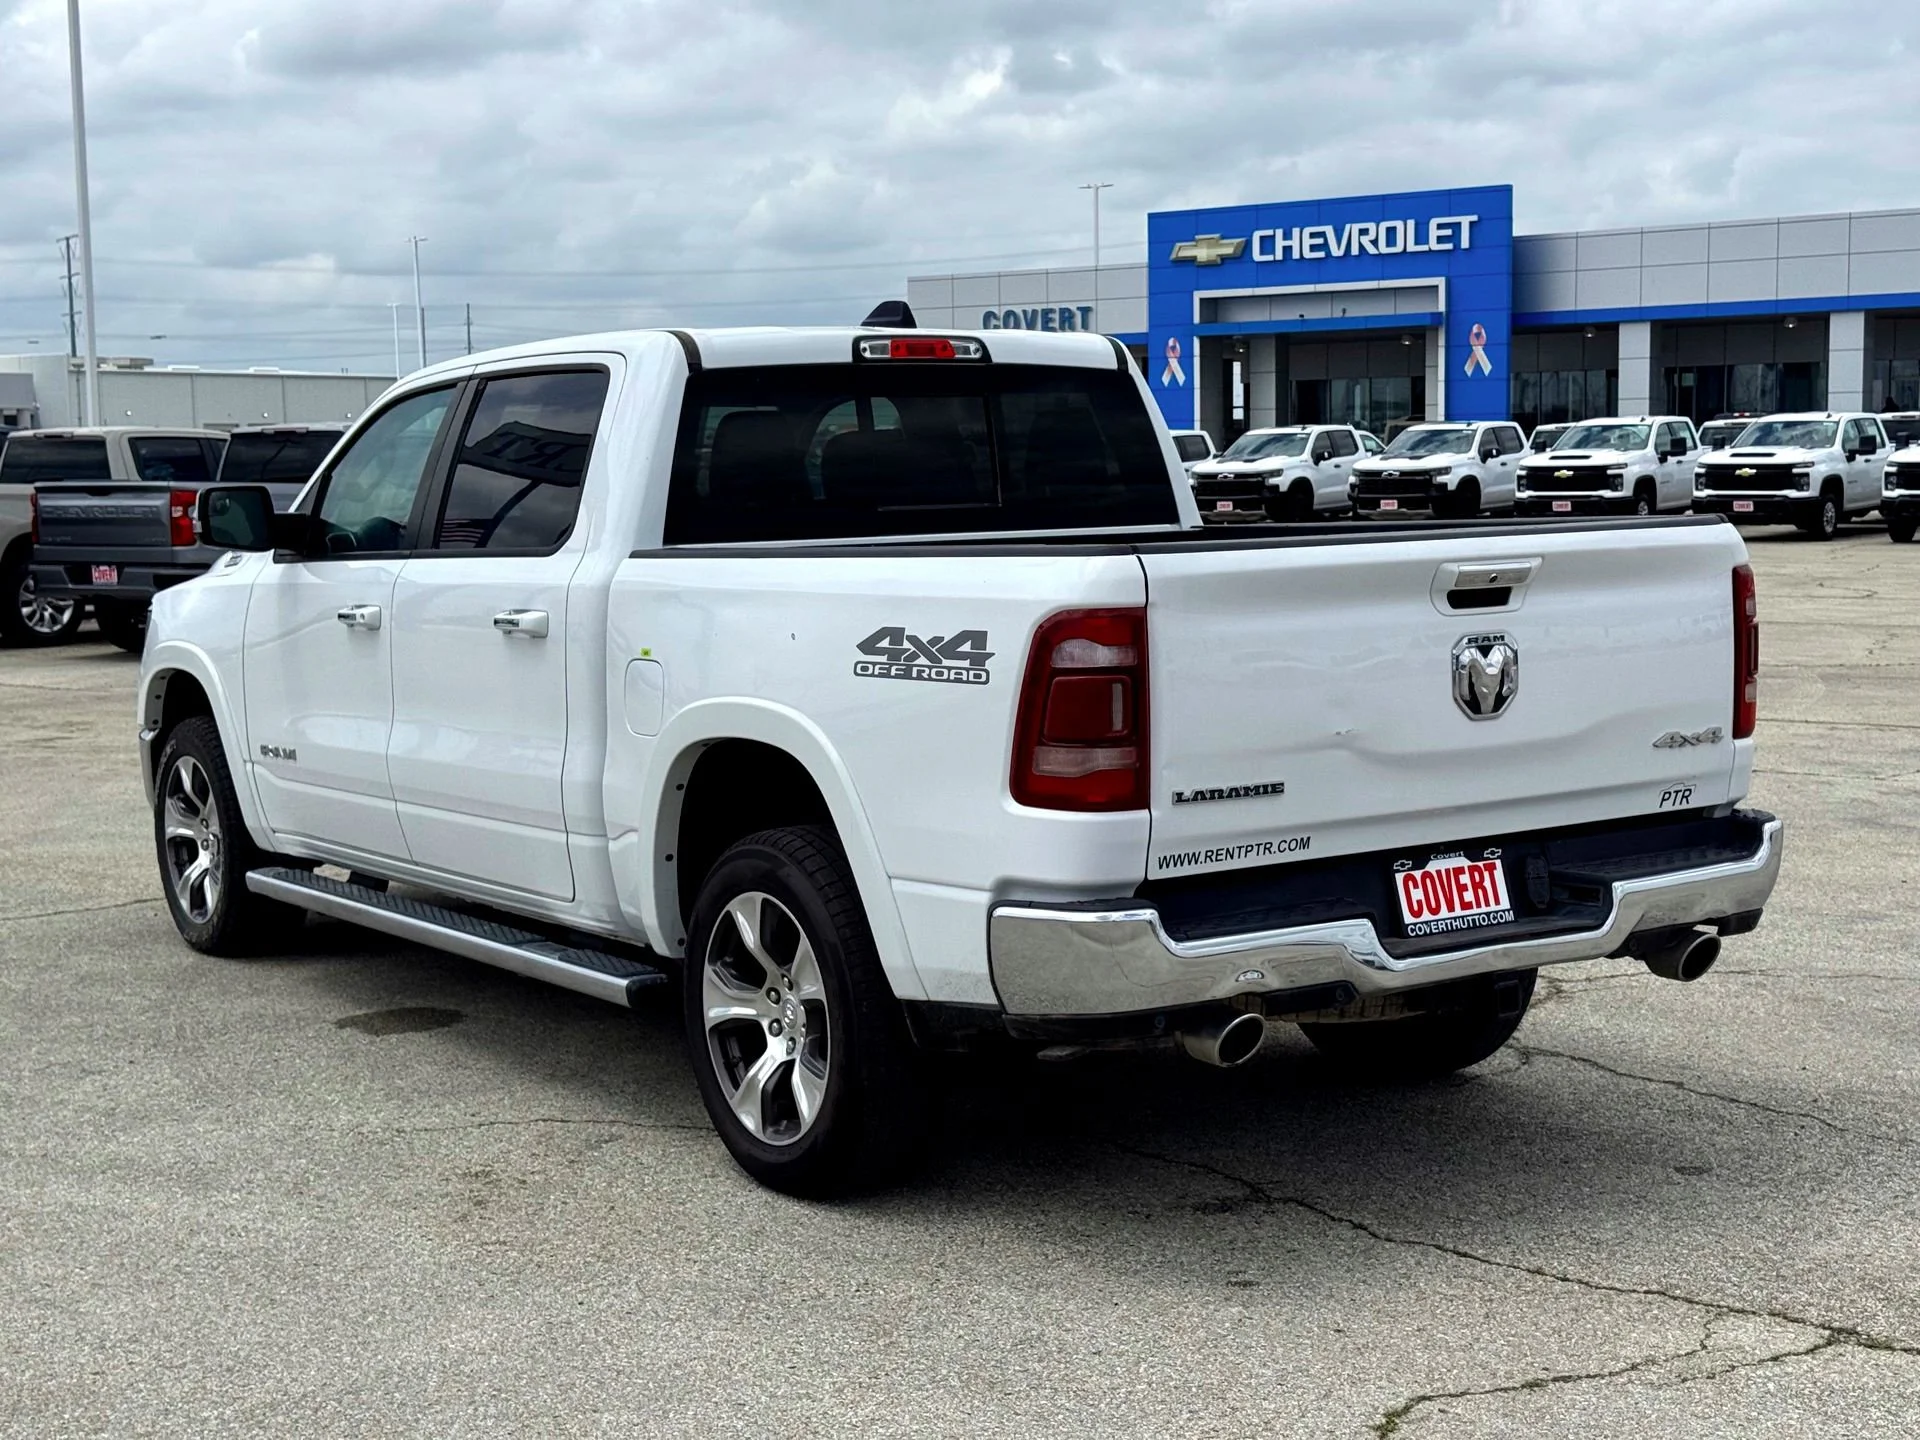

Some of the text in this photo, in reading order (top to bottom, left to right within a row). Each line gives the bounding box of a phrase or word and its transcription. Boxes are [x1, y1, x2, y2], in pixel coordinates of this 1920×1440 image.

[1252, 215, 1479, 262] CHEVROLET
[982, 306, 1094, 332] COVERT
[1466, 635, 1505, 644] RAM
[855, 663, 987, 682] OFF ROAD
[1173, 780, 1285, 805] LARAMIE
[1659, 788, 1693, 809] PTR
[1158, 836, 1311, 870] WWW.RENTPTR.COM
[1430, 850, 1464, 860] Covert
[1402, 861, 1501, 919] COVERT
[1407, 910, 1515, 937] COVERTHUTTO.COM
